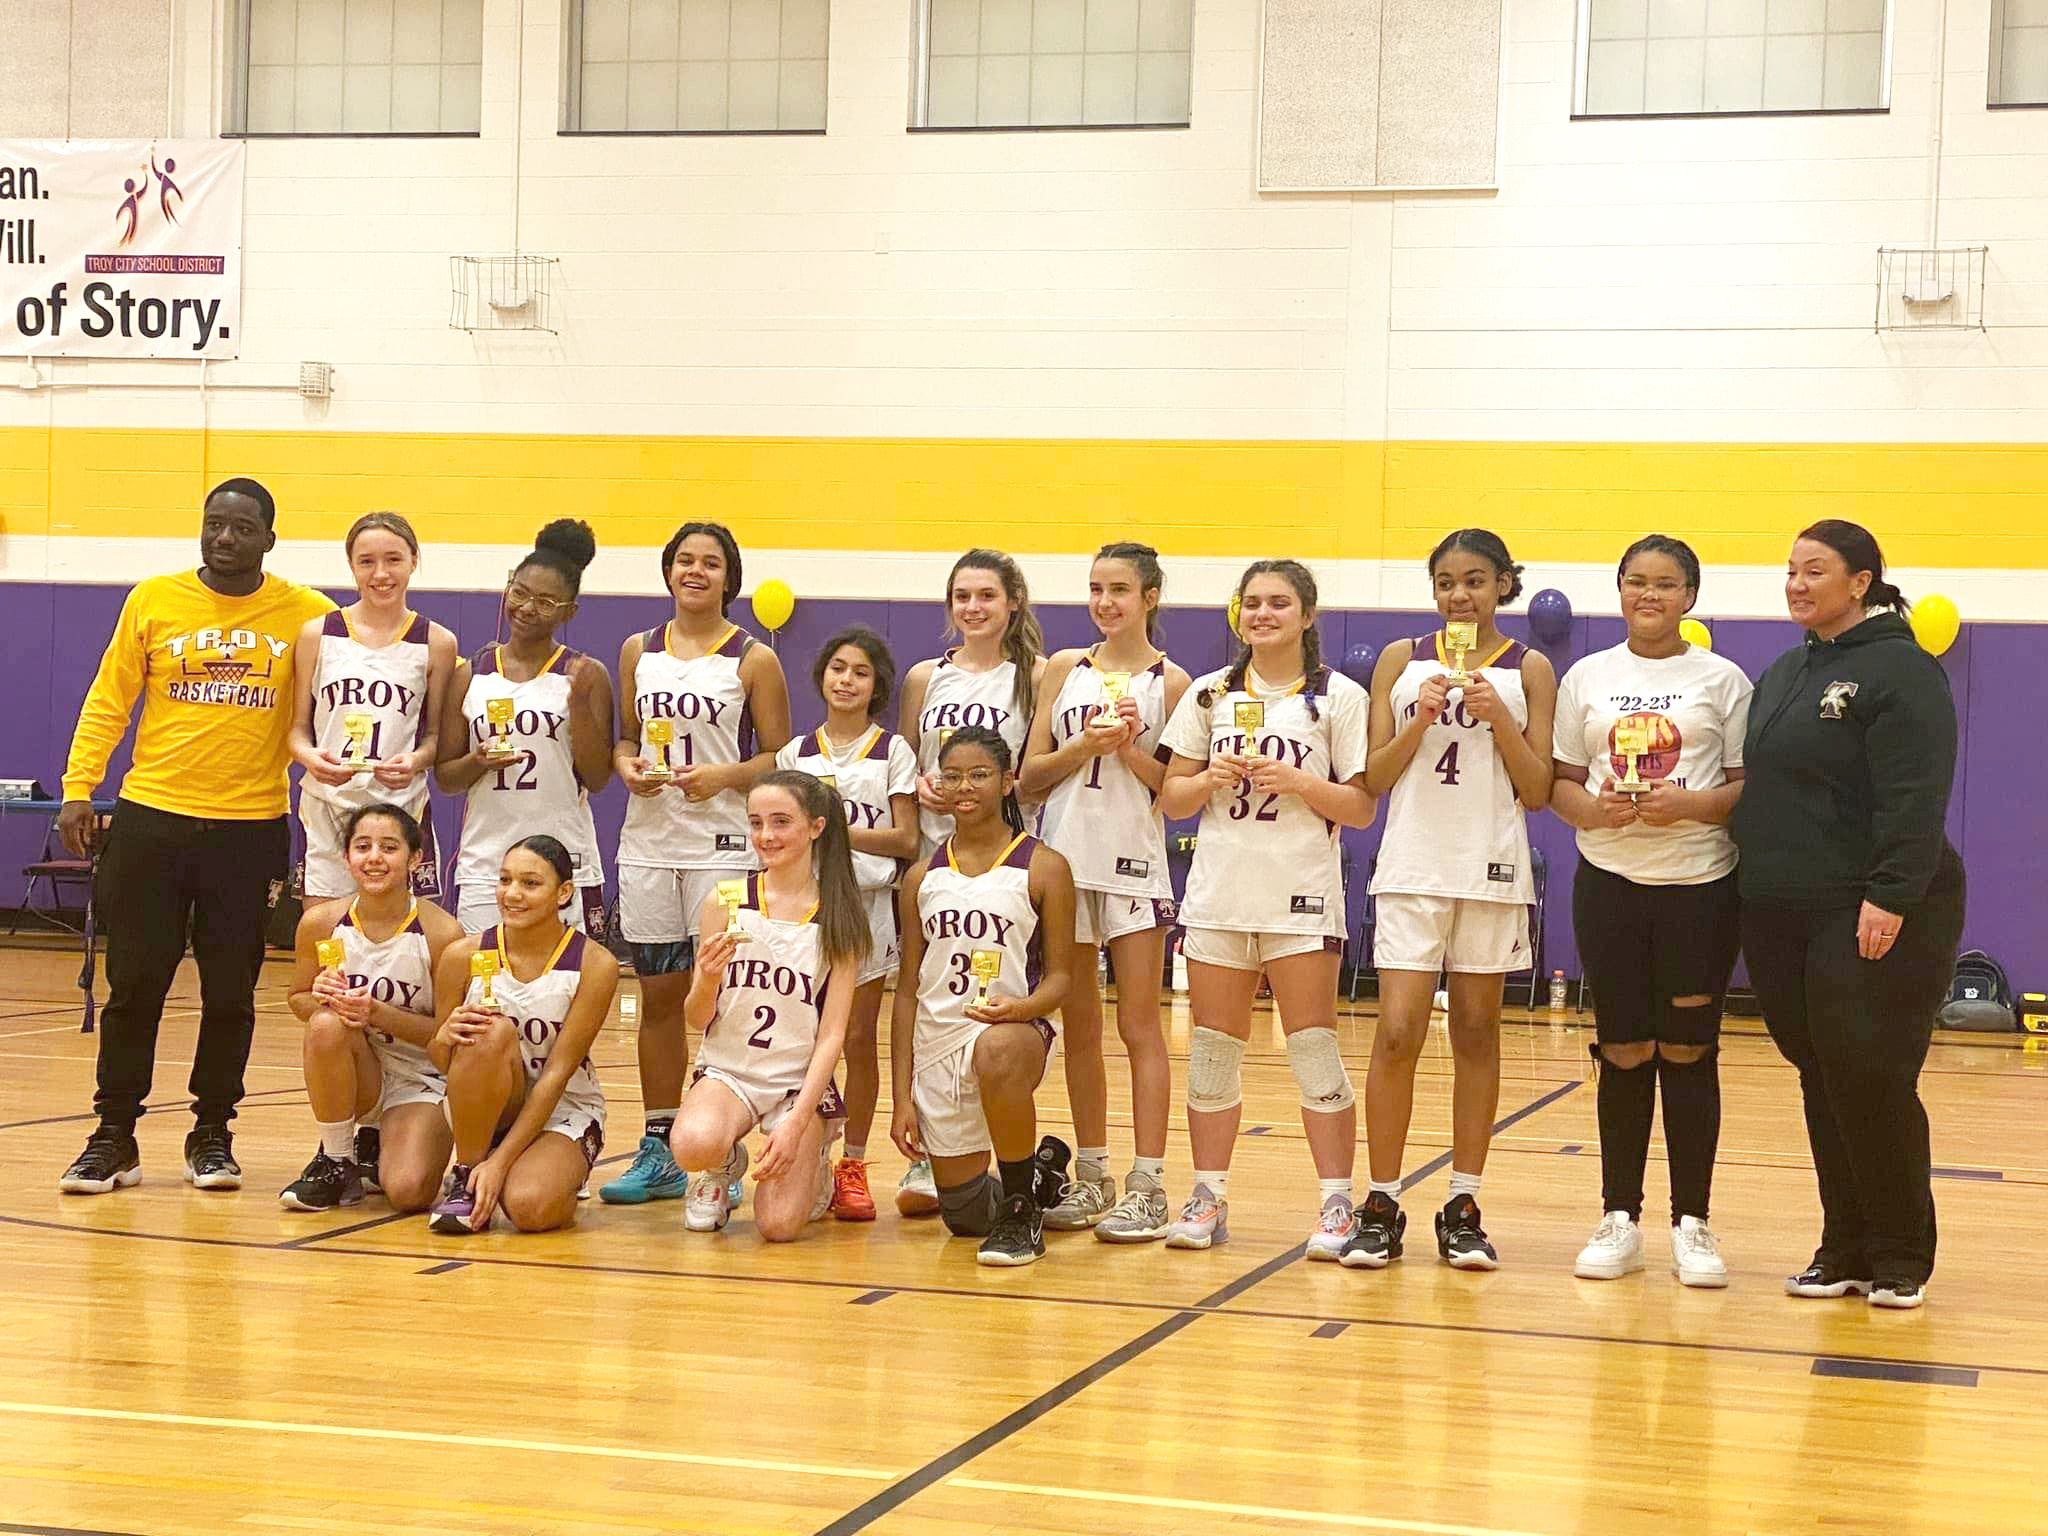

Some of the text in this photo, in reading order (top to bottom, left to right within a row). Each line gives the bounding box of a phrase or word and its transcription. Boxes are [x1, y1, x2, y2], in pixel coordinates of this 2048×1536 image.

[87, 256, 222, 273] TROY CITY SCHOOL DISTRICT
[16, 281, 230, 351] of Story.
[165, 628, 289, 658] TROY
[168, 680, 277, 709] BASKETBALL
[321, 677, 416, 717] TROY
[637, 691, 727, 728] TROY
[1610, 694, 1682, 711] "22-23"
[921, 703, 1010, 736] TROY
[1434, 741, 1461, 786] 4
[925, 909, 1015, 947] TROY
[726, 959, 814, 1006] TROY
[747, 1005, 777, 1050] 2
